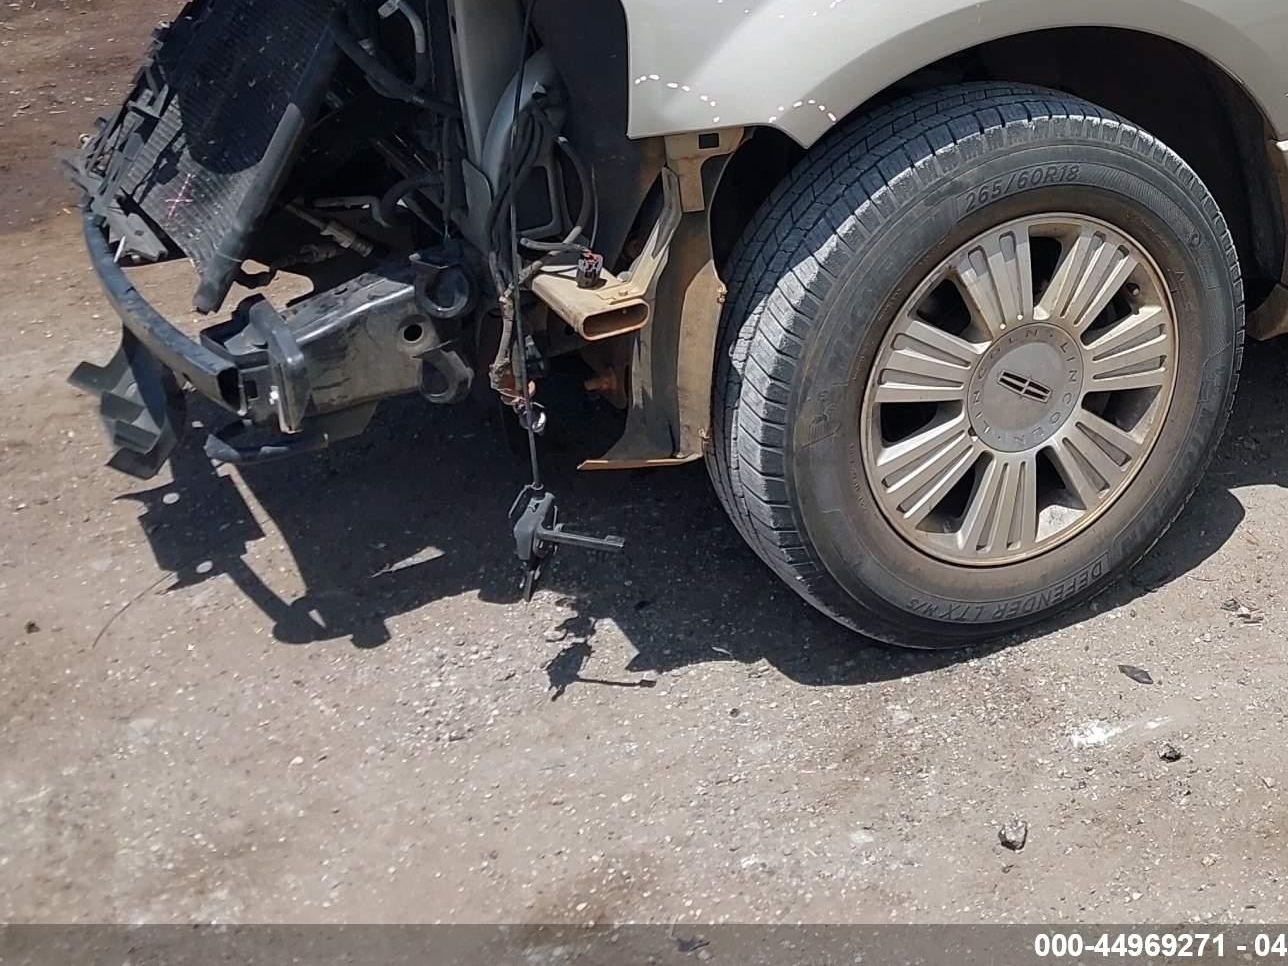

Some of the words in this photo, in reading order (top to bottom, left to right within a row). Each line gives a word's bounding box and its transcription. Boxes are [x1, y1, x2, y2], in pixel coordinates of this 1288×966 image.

[965, 163, 1081, 214] 265/60R18
[939, 599, 983, 622] LTX
[992, 562, 1111, 620] DEFENDER
